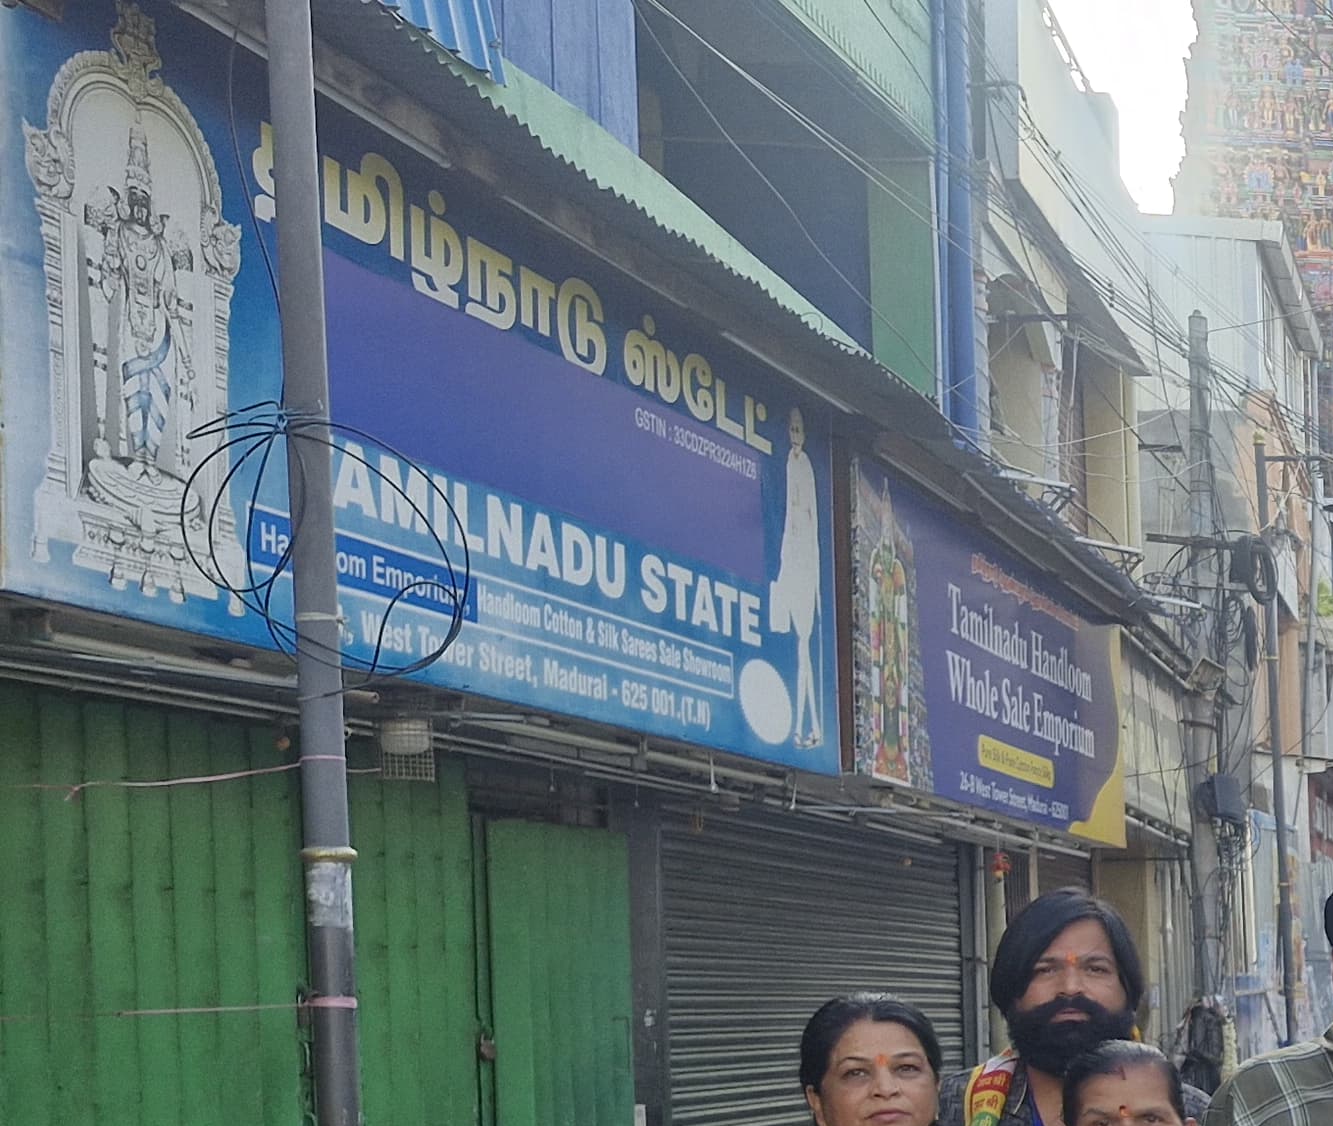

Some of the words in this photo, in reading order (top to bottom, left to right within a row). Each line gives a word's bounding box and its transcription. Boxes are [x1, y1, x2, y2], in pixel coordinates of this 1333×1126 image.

[624, 314, 772, 456] ஸ்டேட்
[635, 407, 667, 438] GSTIN
[329, 434, 626, 599] AMILNADU
[641, 554, 762, 647] STATE
[260, 522, 366, 580] Haom
[477, 584, 540, 628] Handloom
[544, 604, 583, 641] Cotton
[587, 618, 594, 643] &
[598, 621, 618, 652] Silk
[622, 629, 656, 659] Sarees
[659, 640, 681, 668] Sale
[684, 647, 731, 683] Showroom
[361, 611, 412, 653] West
[479, 644, 538, 688] Street,
[544, 659, 607, 700] Madurai
[622, 680, 647, 710] 625
[948, 583, 1028, 669] Tamilnadu
[1031, 630, 1092, 702] Handloom
[946, 650, 998, 719] Whole
[1002, 678, 1030, 733] Sale
[1033, 692, 1095, 758] Emporium
